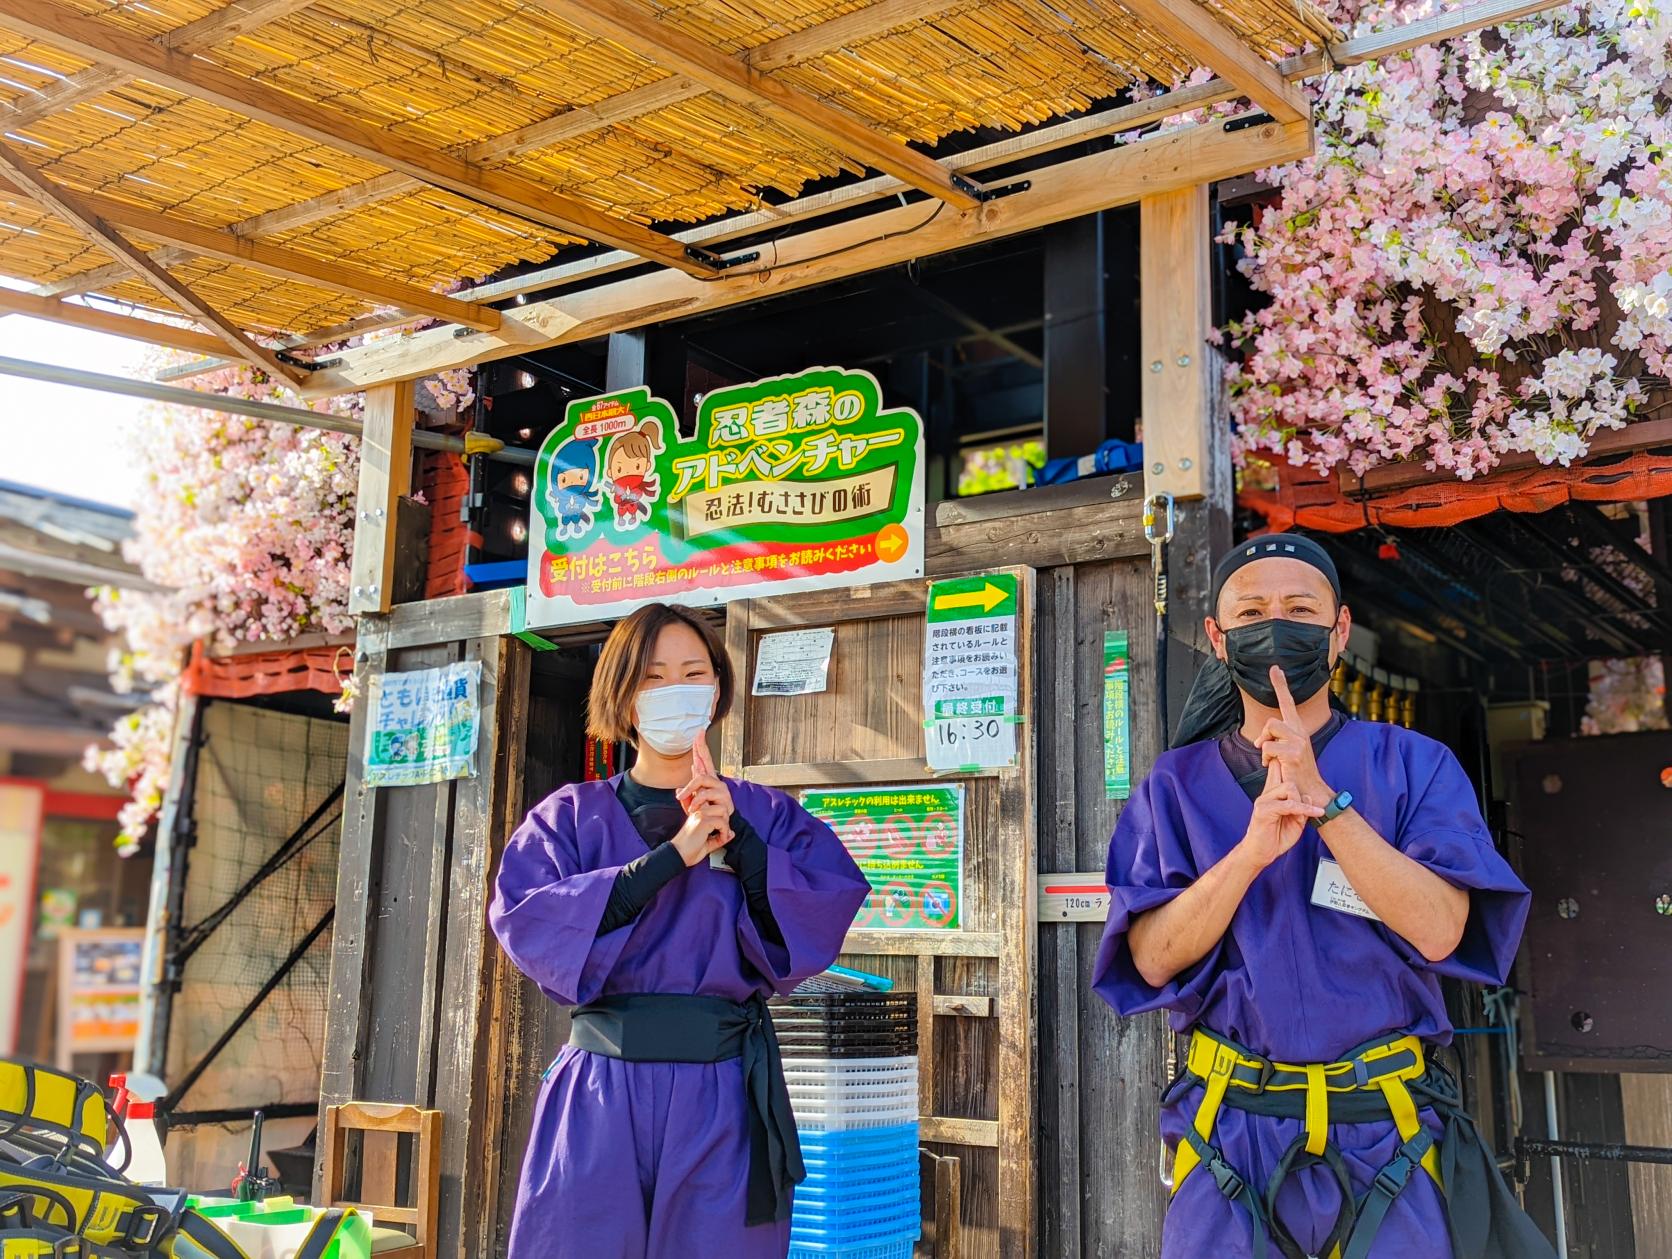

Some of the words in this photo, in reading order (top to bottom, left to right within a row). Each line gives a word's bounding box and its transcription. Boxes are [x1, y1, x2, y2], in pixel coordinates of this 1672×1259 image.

[708, 386, 865, 448] 忍者森の
[582, 424, 598, 436] 全長
[599, 419, 627, 432] 1000m
[668, 429, 904, 502] アドベンチャー
[549, 545, 659, 584] 受付はこちら
[932, 622, 1008, 638] 階段横の看板に記載
[932, 637, 1008, 652] されているルールと
[931, 652, 1008, 666] 注意事項をお読みい
[942, 699, 997, 717] 最終受付
[939, 719, 1000, 746] 16:30
[1065, 897, 1091, 908] 120cm
